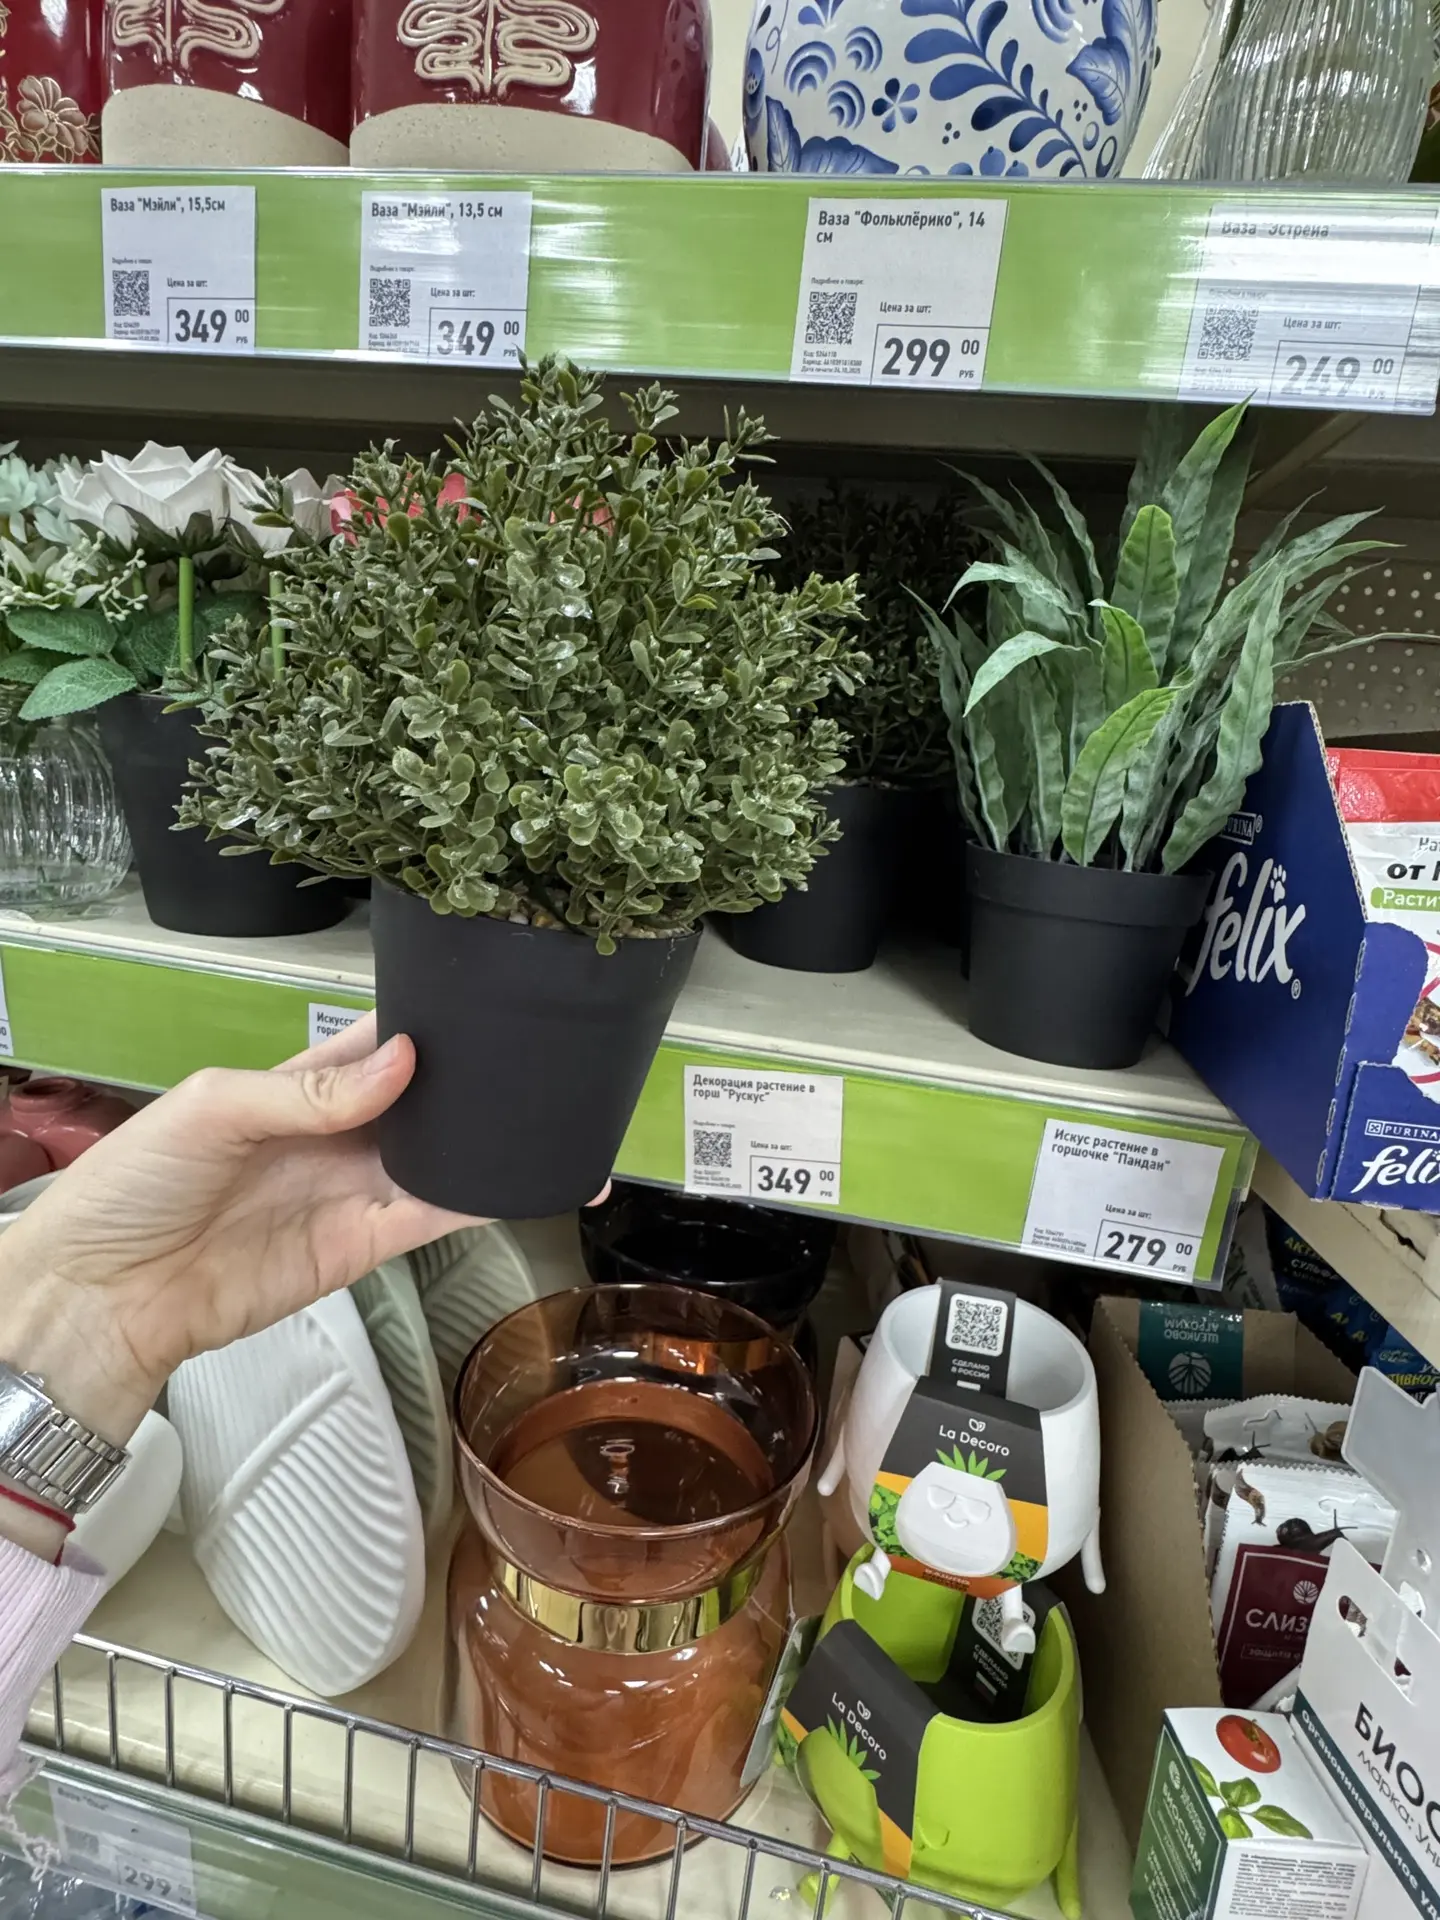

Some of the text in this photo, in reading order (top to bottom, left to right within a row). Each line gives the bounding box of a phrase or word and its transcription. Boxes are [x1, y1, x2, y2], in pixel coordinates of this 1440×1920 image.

[110, 196, 226, 214] Ваза "Мэйли", 15,5см
[371, 202, 503, 219] Ваза "Мэйли", 13,5 см
[818, 210, 986, 230] Ваза "Фольклёрико", 14
[816, 231, 833, 243] см
[166, 278, 185, 288] Цена
[430, 287, 450, 298] Цена
[452, 289, 461, 297] за
[880, 302, 932, 314] Цена за шт:
[175, 309, 227, 343] 349
[235, 309, 249, 323] 00
[1283, 317, 1308, 330] Цена
[1311, 320, 1322, 329] за
[236, 336, 248, 344] РУБ
[437, 320, 495, 356] 349
[503, 320, 520, 336] 00
[503, 349, 516, 357] РУБ
[881, 337, 980, 377] 299 00
[959, 370, 974, 378] РУБ
[1280, 354, 1361, 397] 249
[1372, 357, 1394, 375] 00
[1224, 817, 1253, 838] URINA
[1386, 863, 1426, 881] от
[1383, 889, 1440, 909] Расти
[1185, 851, 1306, 997] felix
[692, 1074, 816, 1093] Декорация растение в
[693, 1088, 770, 1104] горш "Рускус"
[1385, 1125, 1438, 1141] PURINA
[750, 1140, 769, 1150] Цена
[1054, 1128, 1159, 1157] Искус растение в
[1051, 1143, 1171, 1171] горшочке "Пандан"
[1350, 1145, 1440, 1194] feli
[757, 1165, 811, 1195] 349
[819, 1170, 834, 1182] 00
[1105, 1203, 1126, 1215] Цена
[1127, 1208, 1137, 1216] за
[1103, 1231, 1166, 1267] 279
[1175, 1242, 1193, 1256] 00
[1172, 1263, 1186, 1273] РУБ
[951, 1358, 990, 1372] СДЕЛАНО
[957, 1367, 990, 1380] РОССИИ
[939, 1424, 1010, 1456] La Decoro
[832, 1691, 887, 1761] La Decoro
[1301, 1709, 1419, 1890] Органоминеральное
[124, 1865, 172, 1897] 299
